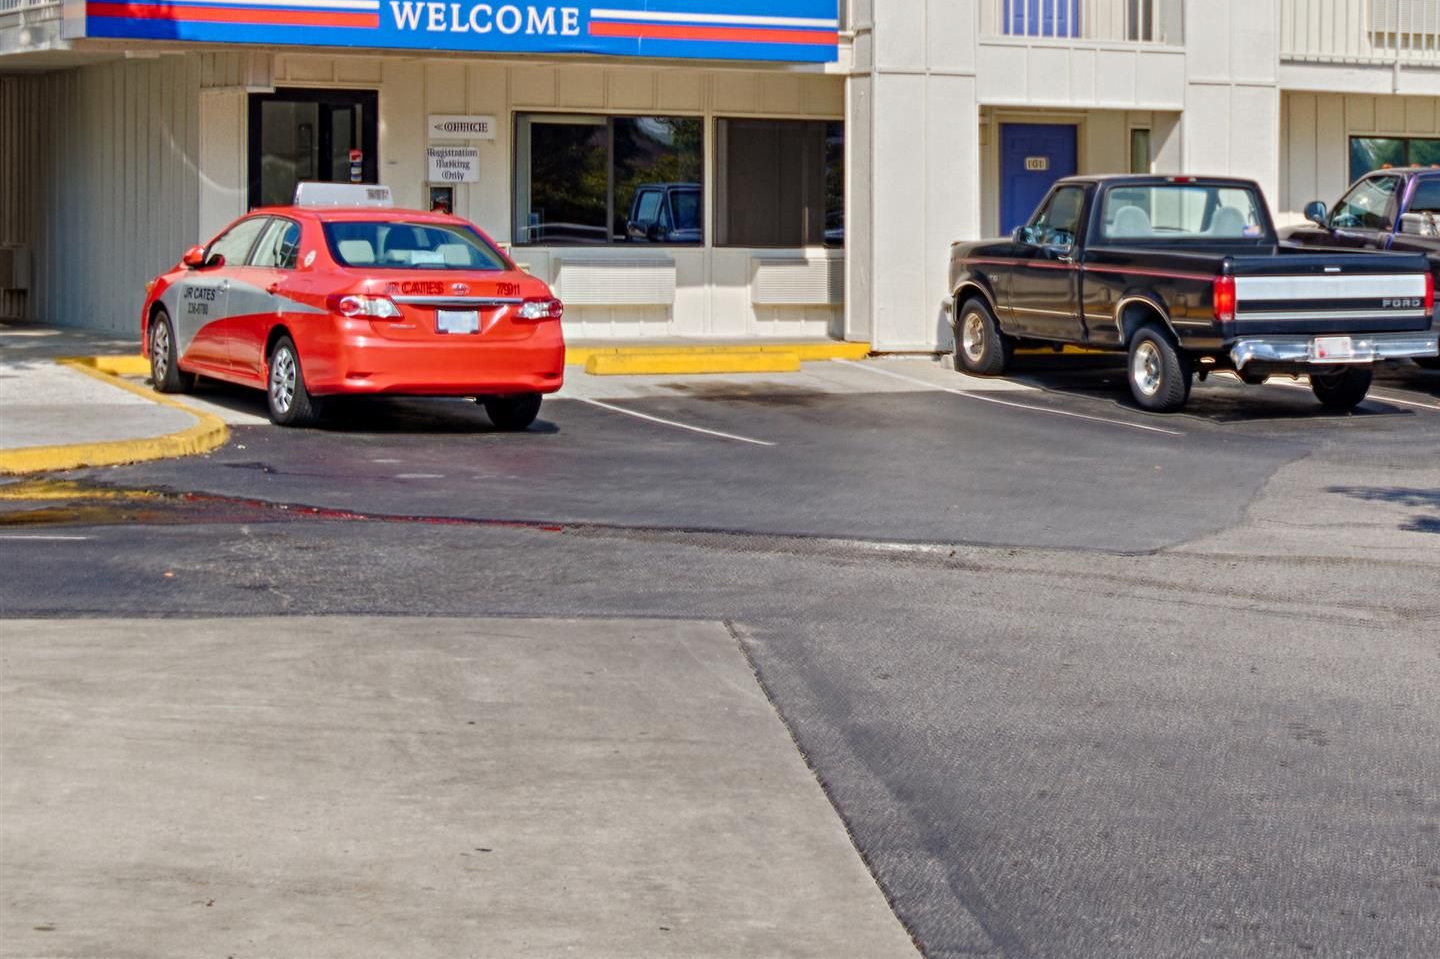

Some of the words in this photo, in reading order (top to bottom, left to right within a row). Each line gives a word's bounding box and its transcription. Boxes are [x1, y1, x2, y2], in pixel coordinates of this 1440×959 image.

[389, 0, 581, 36] WELCOME
[184, 287, 194, 299] JR
[194, 287, 216, 301] CATES
[1382, 298, 1421, 308] FORD
